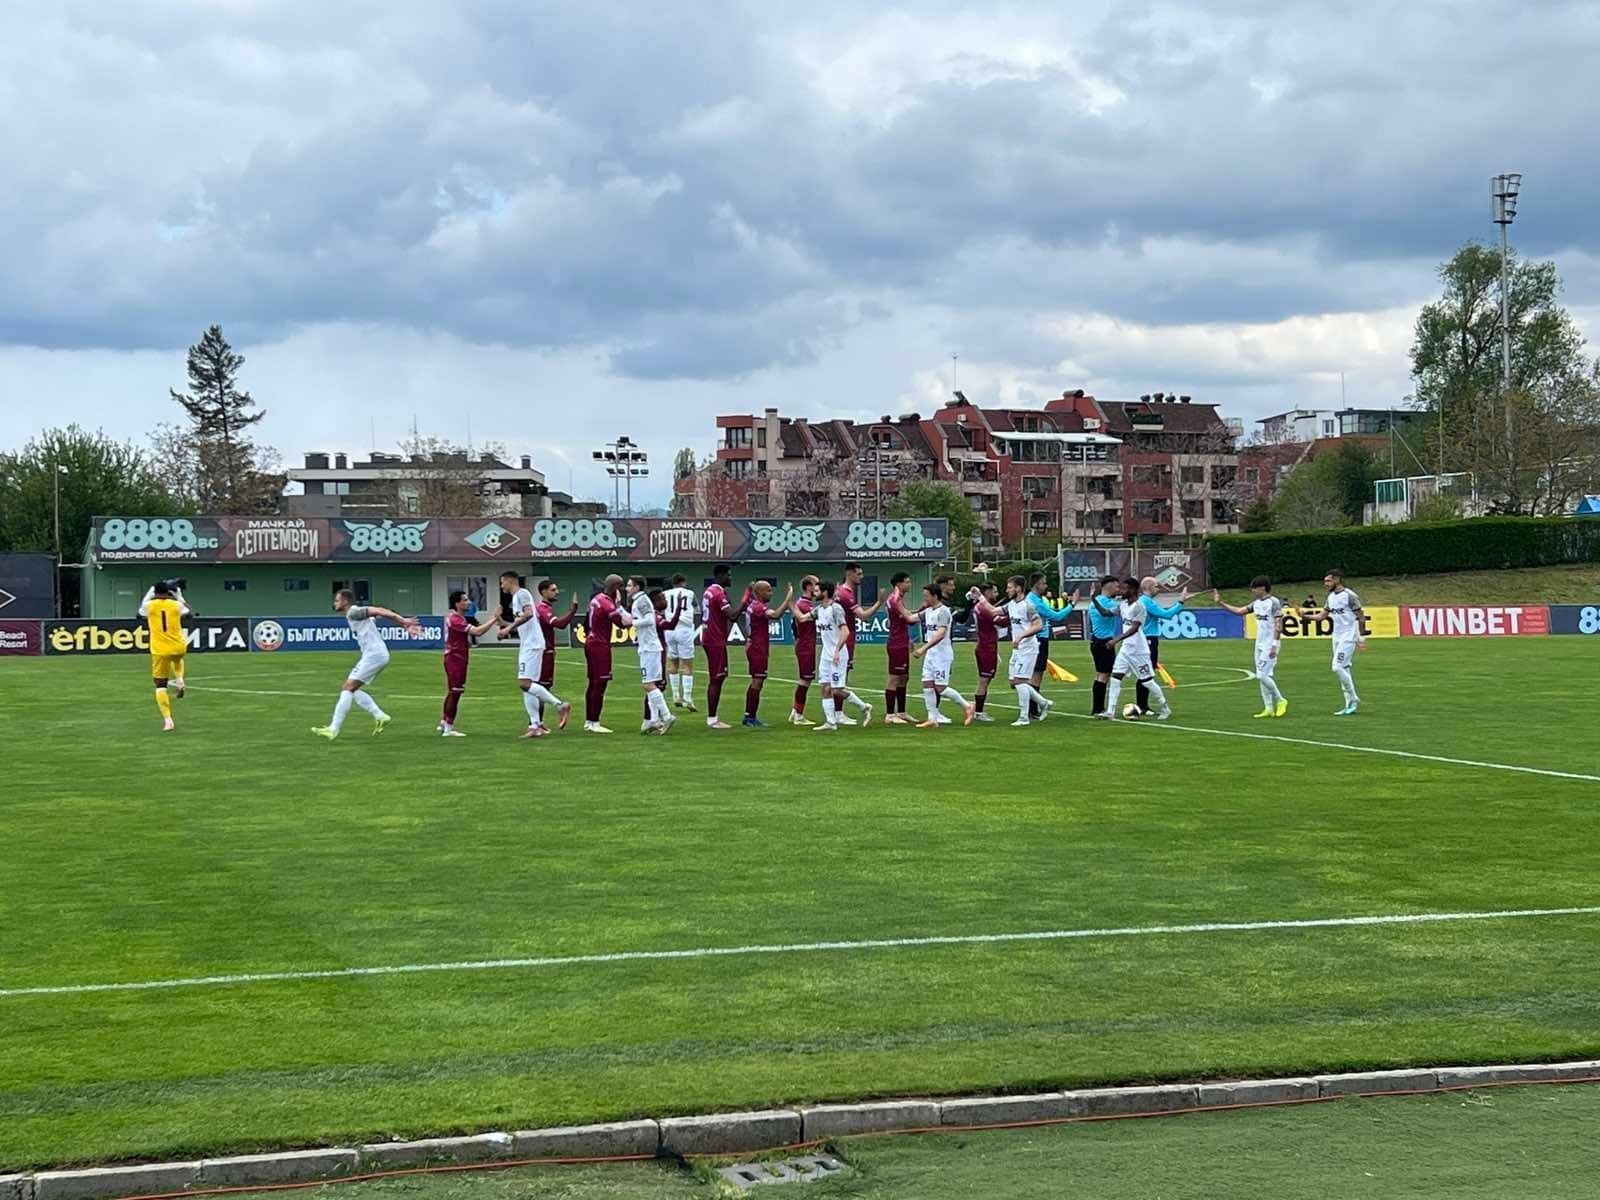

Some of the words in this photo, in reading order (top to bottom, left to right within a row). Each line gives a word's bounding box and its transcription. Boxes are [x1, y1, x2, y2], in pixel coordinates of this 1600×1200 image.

[248, 518, 305, 528] МАЧКАЙ
[661, 520, 712, 529] МАЧКАЙ
[235, 528, 318, 559] СЕПТЕМВРИ
[350, 527, 423, 552] 8888
[649, 528, 724, 558] СЕПТЕМВРИ
[753, 528, 820, 552] 8888
[161, 610, 167, 632] 1
[1409, 607, 1523, 635] WINBET
[185, 627, 246, 649] ИГА
[287, 628, 350, 642] БЪЛГАРСКИ
